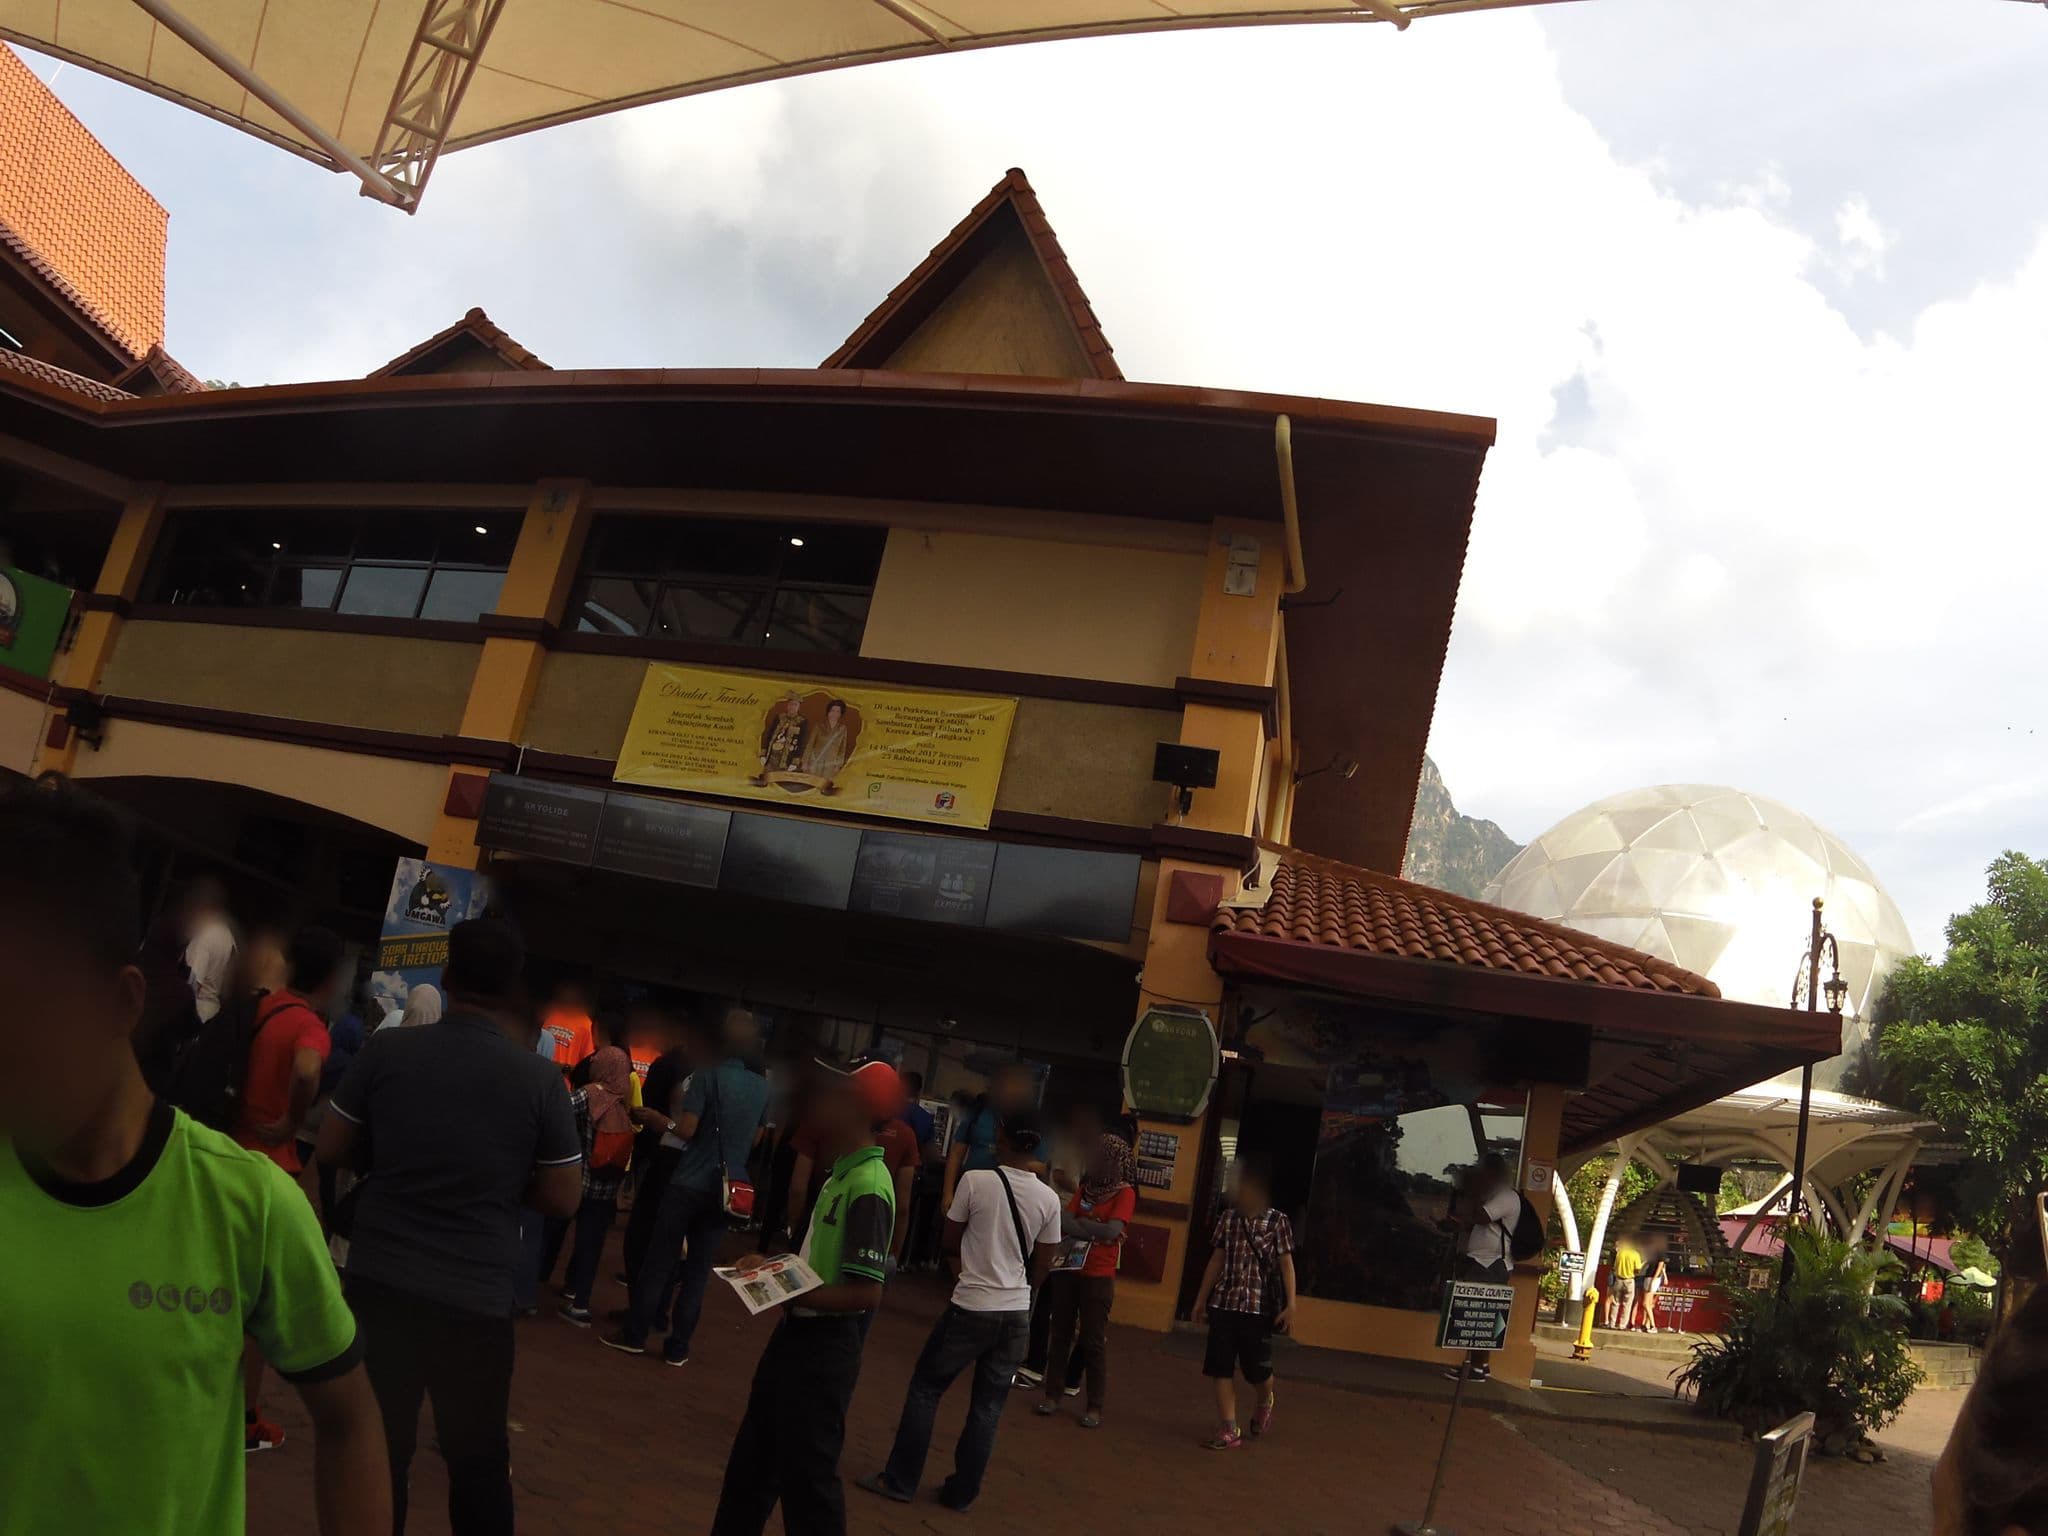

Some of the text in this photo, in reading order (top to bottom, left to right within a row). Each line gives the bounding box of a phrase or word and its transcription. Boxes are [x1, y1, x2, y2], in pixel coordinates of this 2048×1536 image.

[404, 908, 446, 925] UMGAWA
[410, 939, 449, 954] THROUG
[380, 954, 400, 968] THE
[823, 1193, 843, 1226] 1
[1455, 1285, 1485, 1297] TICKETING
